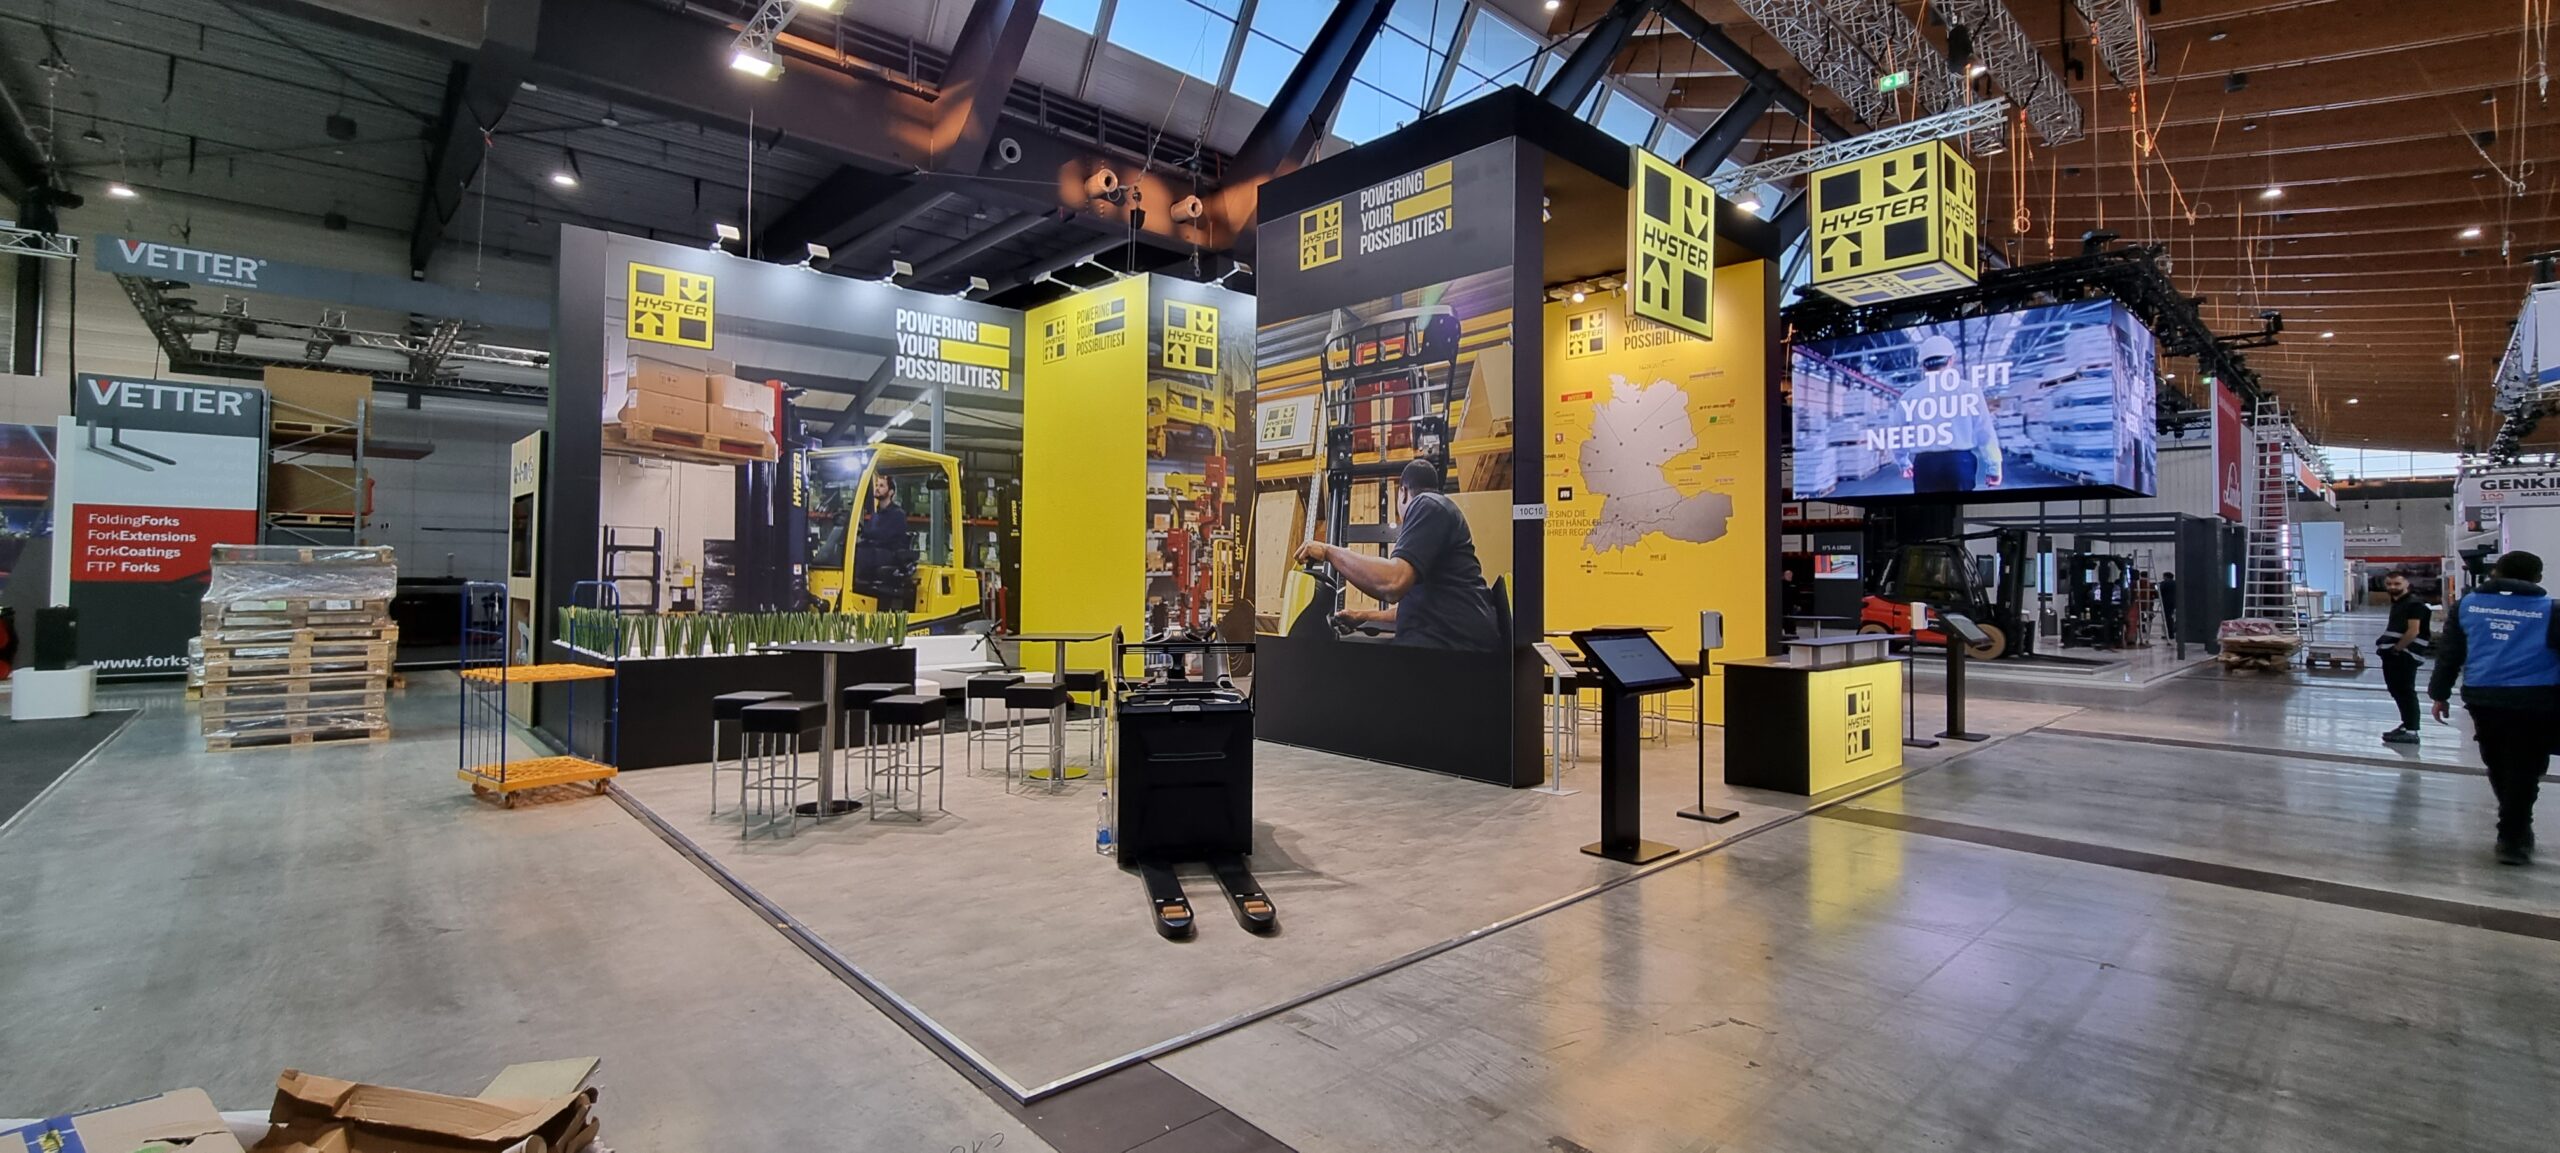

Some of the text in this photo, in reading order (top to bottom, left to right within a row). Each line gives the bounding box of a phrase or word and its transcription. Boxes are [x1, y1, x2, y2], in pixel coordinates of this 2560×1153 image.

[1360, 172, 1423, 211] POWERING
[1361, 205, 1392, 232] YOUR
[1821, 194, 1928, 234] HYSTER
[1945, 194, 1974, 231] HYSTER
[1303, 227, 1339, 247] HYSTER
[1360, 211, 1445, 255] POSSIBILITIES
[1643, 223, 1708, 271] HYSTER
[635, 296, 708, 317] HYSTER
[1076, 302, 1110, 324] POWERING
[896, 308, 978, 343] POWERING
[1077, 323, 1093, 340] YOUR
[1569, 329, 1604, 340] HYSTER
[896, 332, 939, 359] YOUR
[1045, 335, 1065, 346] HYSTER
[1076, 332, 1121, 357] POSSIBILITIES
[1167, 329, 1214, 346] HYSTER
[895, 355, 1001, 390] POSSIBILITIES
[1925, 361, 2013, 393] TO FIT
[1900, 393, 1979, 422] YOUR
[1866, 422, 1953, 450] NEEDS
[793, 452, 802, 507] HYSTER
[2480, 477, 2560, 490] GENKI
[88, 513, 180, 527] FoldingForks
[1520, 507, 1543, 516] 10C10
[1555, 510, 1572, 518] SIND
[1574, 509, 1586, 518] DIE
[88, 529, 197, 542] ForkExtensions
[87, 545, 181, 559] ForkCoatings
[86, 561, 160, 572] FTP Forks
[2468, 605, 2543, 619] Standaufsicht
[2491, 632, 2509, 641] 139
